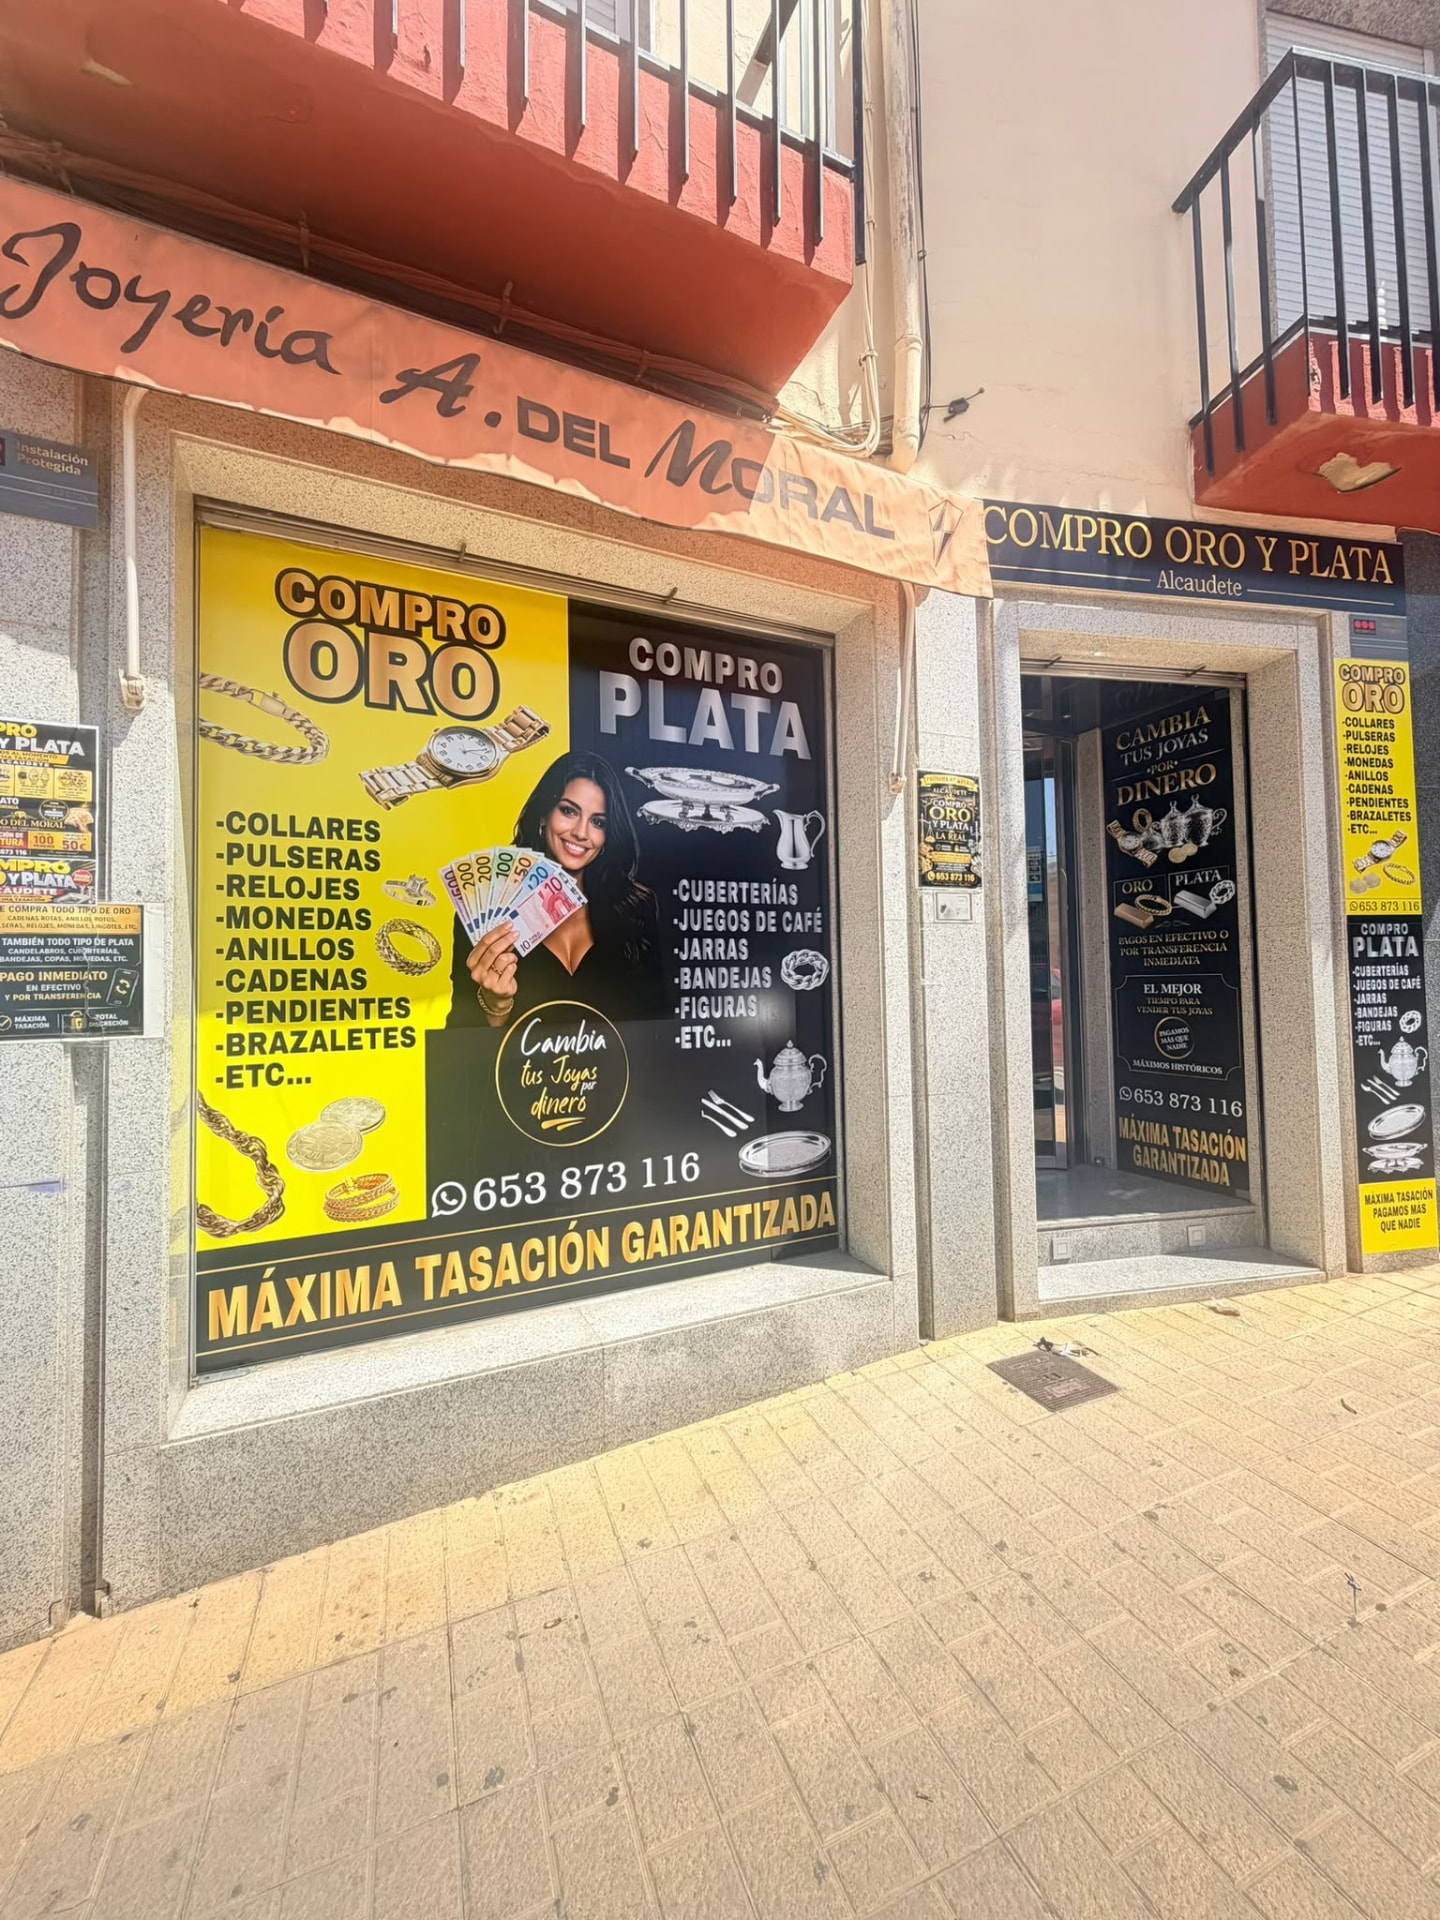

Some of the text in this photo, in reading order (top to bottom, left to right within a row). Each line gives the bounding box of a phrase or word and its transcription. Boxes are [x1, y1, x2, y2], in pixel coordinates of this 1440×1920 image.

[0, 222, 342, 374] Joyería
[517, 396, 630, 468] DEL
[645, 419, 896, 540] MORAL
[17, 441, 88, 466] Instalación
[17, 452, 81, 475] Protegida
[983, 505, 1395, 585] COMPRO ORO Y PLATA
[1157, 570, 1243, 597] Alcaudete
[276, 568, 505, 648] COMPRO
[284, 619, 500, 721] ORO
[628, 637, 784, 694] COMPRO
[1339, 664, 1405, 684] COMPRO
[1342, 681, 1405, 714] ORO
[599, 670, 812, 760] PLATA
[1115, 705, 1212, 750] CAMBIA
[15, 736, 85, 756] PLATA
[1120, 728, 1209, 766] TUS JOYAS
[1116, 763, 1216, 806] DINERO
[929, 806, 971, 822] ORO
[933, 799, 966, 809] COMPRO
[10, 819, 29, 827] DEL
[31, 820, 66, 829] MORAL
[216, 811, 381, 842] -COLLARES
[940, 820, 969, 831] PLATA
[33, 835, 55, 844] 100
[935, 831, 946, 840] LA
[216, 842, 381, 872] -PULSERAS
[496, 852, 513, 879] 100
[7, 873, 20, 885] Y
[22, 871, 77, 889] PLATA
[457, 862, 476, 891] 200
[475, 856, 492, 884] 200
[935, 872, 949, 881] 653
[950, 872, 963, 881] 873
[1175, 869, 1222, 886] PLATA
[216, 874, 360, 900] -RELOJES
[544, 876, 563, 892] 10
[1121, 879, 1153, 894] ORO
[8, 905, 48, 913] COMPRA
[51, 906, 75, 914] TODO
[78, 906, 97, 914] TIPO
[113, 907, 131, 915] ORO
[1359, 901, 1419, 912] 653 873 116
[216, 905, 372, 931] -MONEDAS
[755, 911, 777, 933] DE
[782, 907, 823, 933] CAFÉ
[1118, 930, 1229, 945] PAGOS EN EFECTIVO O
[1360, 923, 1408, 936] COMPRO
[2, 936, 134, 946] TAMBIÉN TODO TIPO DE PLATA
[216, 937, 355, 961] -ANILLOS
[1120, 942, 1228, 956] POR TRANSFERENCIA
[1352, 936, 1419, 958] PLATA
[1143, 956, 1200, 966] INMEDIATA
[0, 971, 108, 982] PAGO INMEDIATO
[216, 967, 368, 993] -CADENAS
[1389, 979, 1399, 989] DE
[1401, 975, 1422, 989] CAFÉ
[34, 992, 101, 1000] TRANSFERENCIA
[1143, 983, 1202, 996] EL MEJOR
[216, 996, 411, 1024] -PENDIENTES
[1136, 1006, 1169, 1014] VENDER
[1188, 1007, 1213, 1016] JOYAS
[1146, 997, 1200, 1005] TIEMPO PARA
[14, 1014, 47, 1023] MÁXIMA
[14, 1021, 50, 1030] TASACIÓN
[89, 1019, 129, 1027] DISCRECIÓN
[216, 1026, 416, 1057] -BRAZALETES
[520, 1017, 606, 1056] Cambia
[521, 1055, 597, 1091] tus Joyas
[1132, 1058, 1223, 1075] MÁXIMOS HISTÓRICOS
[580, 1080, 597, 1095] por
[530, 1087, 586, 1119] dinero
[1134, 1088, 1243, 1118] 653 873 116
[1118, 1113, 1247, 1162] MÁXIMA TASACIÓN
[1133, 1144, 1230, 1186] GARANTIZADA
[473, 1152, 700, 1211] 653 873 116
[1364, 1187, 1433, 1205] MÁXIMA TASACIÓN
[1373, 1201, 1426, 1219] PAGAMOS MÁS
[1380, 1217, 1421, 1233] QUE NADIE
[208, 1191, 835, 1341] MÁXIMA TASACIÓN GARANTIZADA
